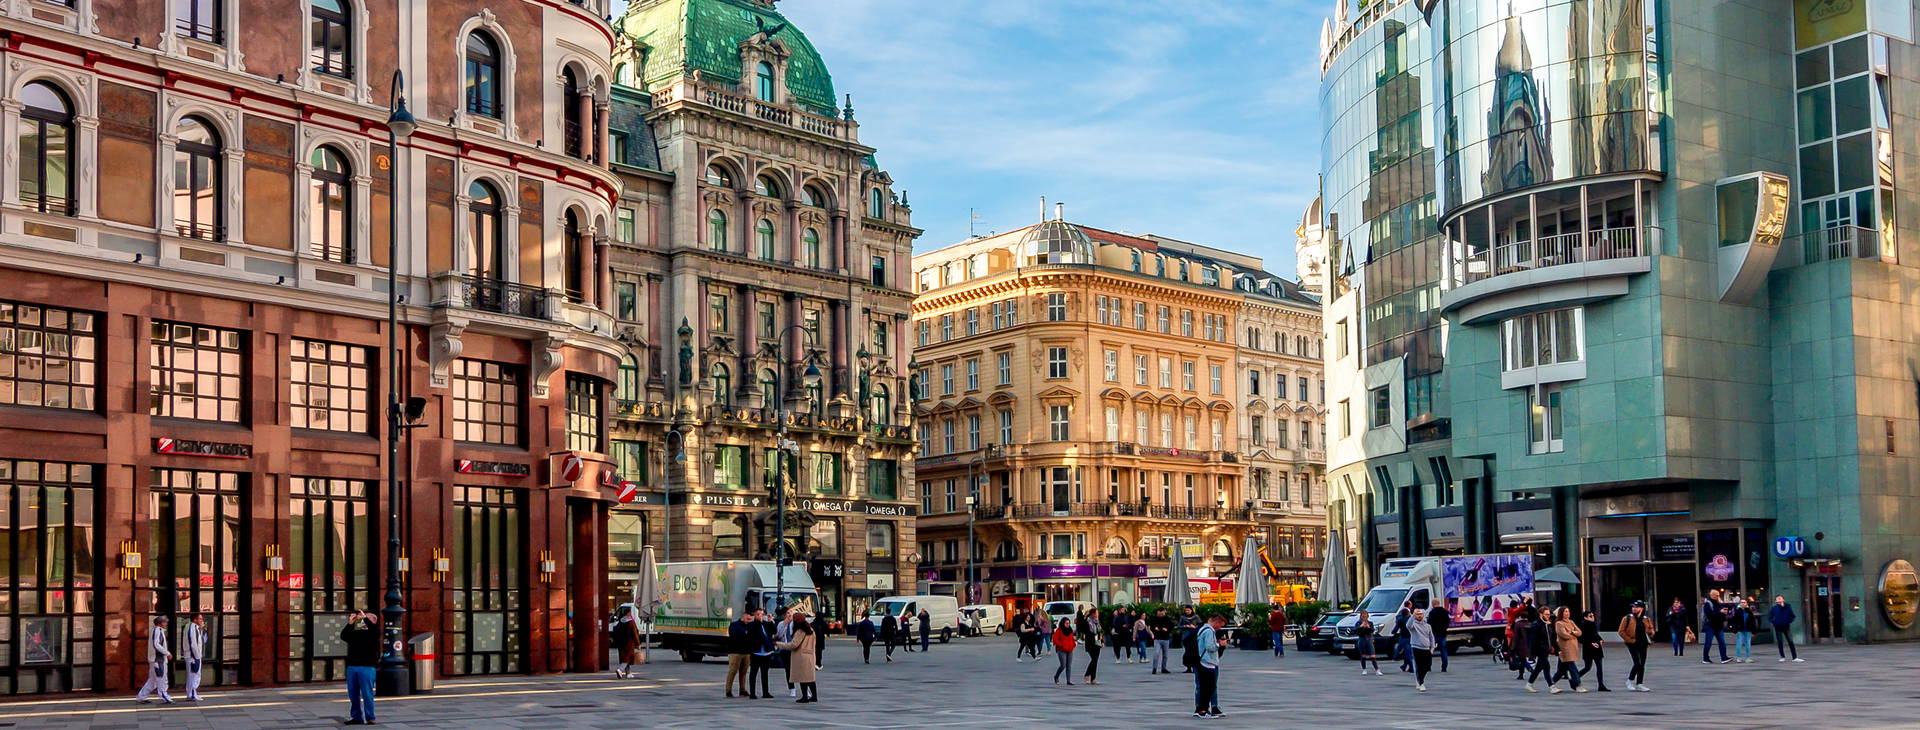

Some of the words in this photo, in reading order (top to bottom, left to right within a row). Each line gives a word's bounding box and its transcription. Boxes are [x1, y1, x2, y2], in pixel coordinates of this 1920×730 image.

[706, 496, 748, 506] PILSTL
[813, 502, 841, 511] OMEGA
[870, 507, 896, 515] OMEGA
[1776, 541, 1790, 555] U
[1795, 541, 1804, 555] U
